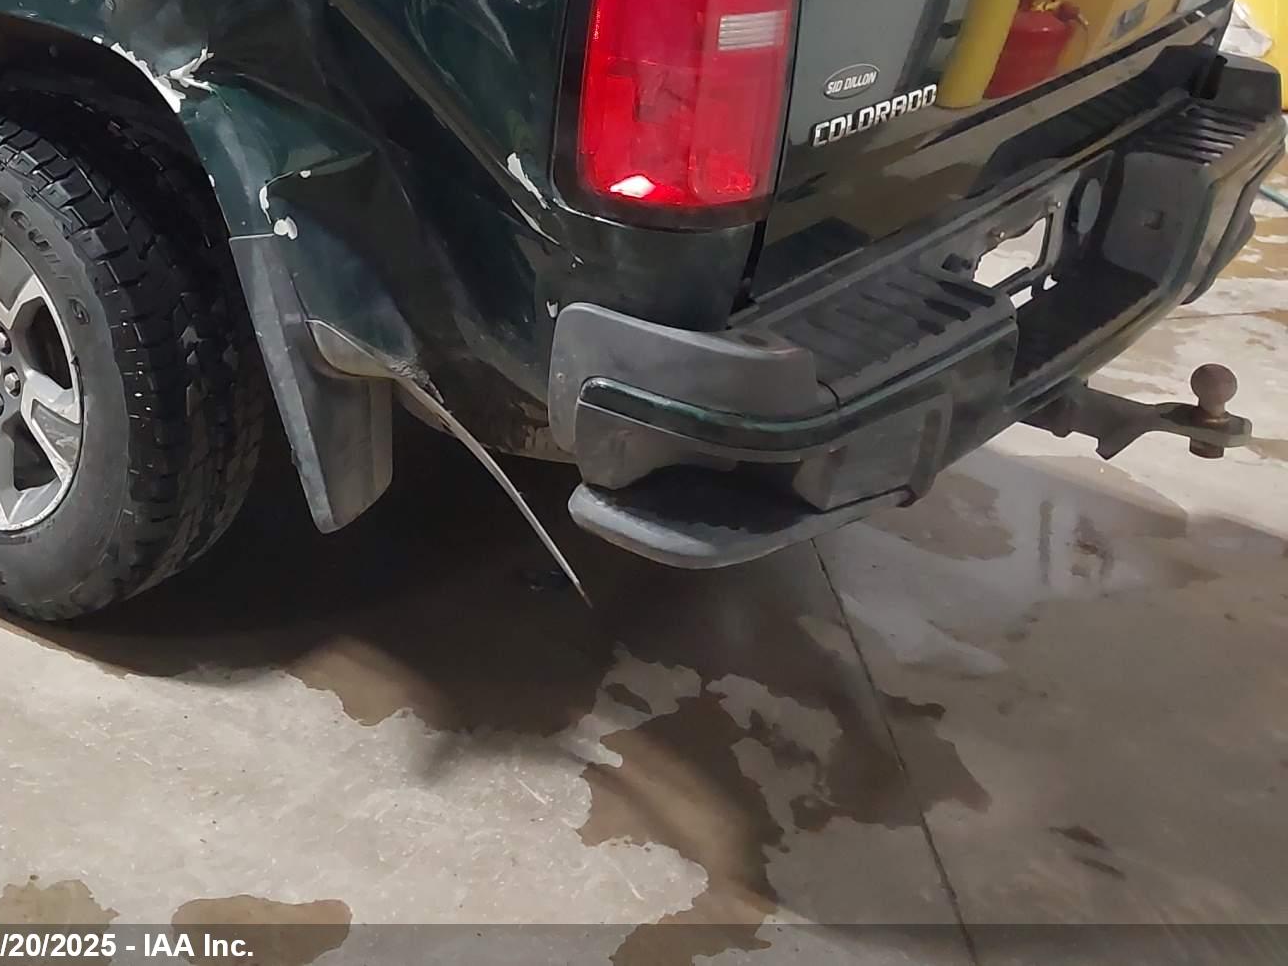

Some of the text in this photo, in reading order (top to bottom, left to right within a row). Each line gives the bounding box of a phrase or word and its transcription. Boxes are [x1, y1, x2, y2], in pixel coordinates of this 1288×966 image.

[826, 71, 877, 95] SID DILLON
[812, 83, 937, 147] COLORADO
